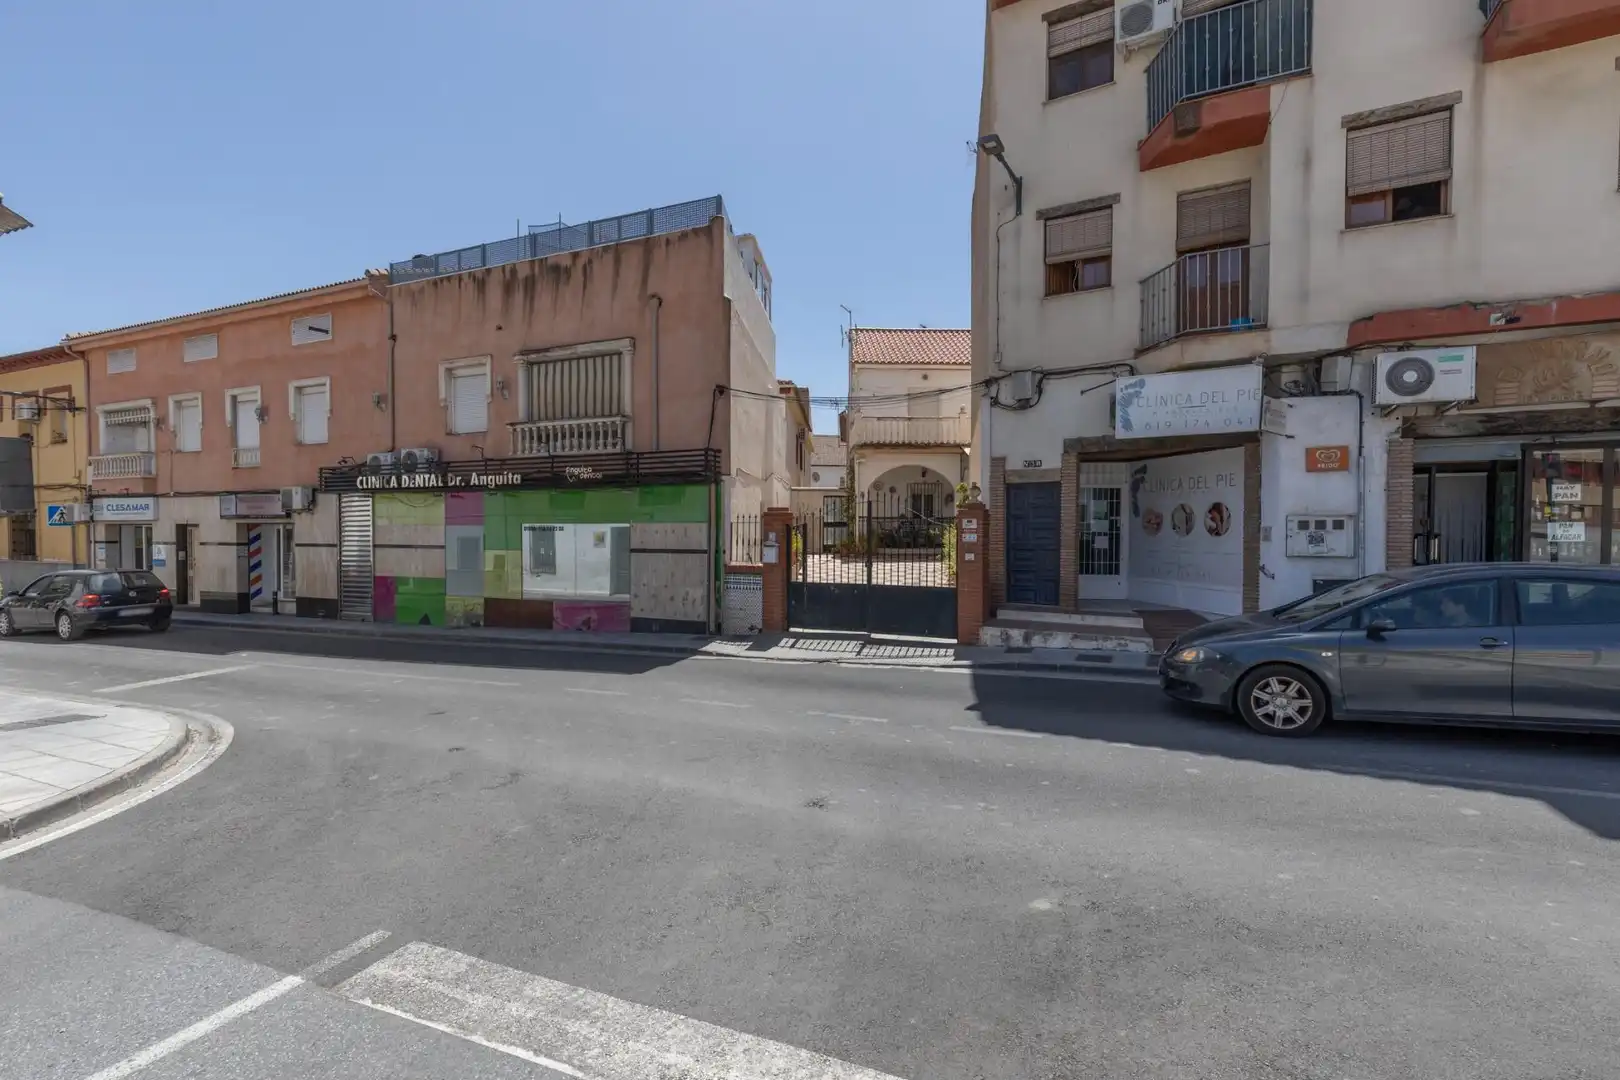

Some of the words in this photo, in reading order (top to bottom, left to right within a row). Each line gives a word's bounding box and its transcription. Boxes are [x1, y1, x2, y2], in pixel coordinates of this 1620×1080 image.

[1200, 391, 1229, 404] DEL
[1237, 388, 1260, 402] PIE
[1145, 421, 1172, 430] 619
[1224, 417, 1253, 427] 041
[401, 473, 444, 488] DENTAL
[448, 472, 465, 487] Dr.
[1188, 475, 1210, 490] DEL
[1216, 473, 1236, 488] PIE
